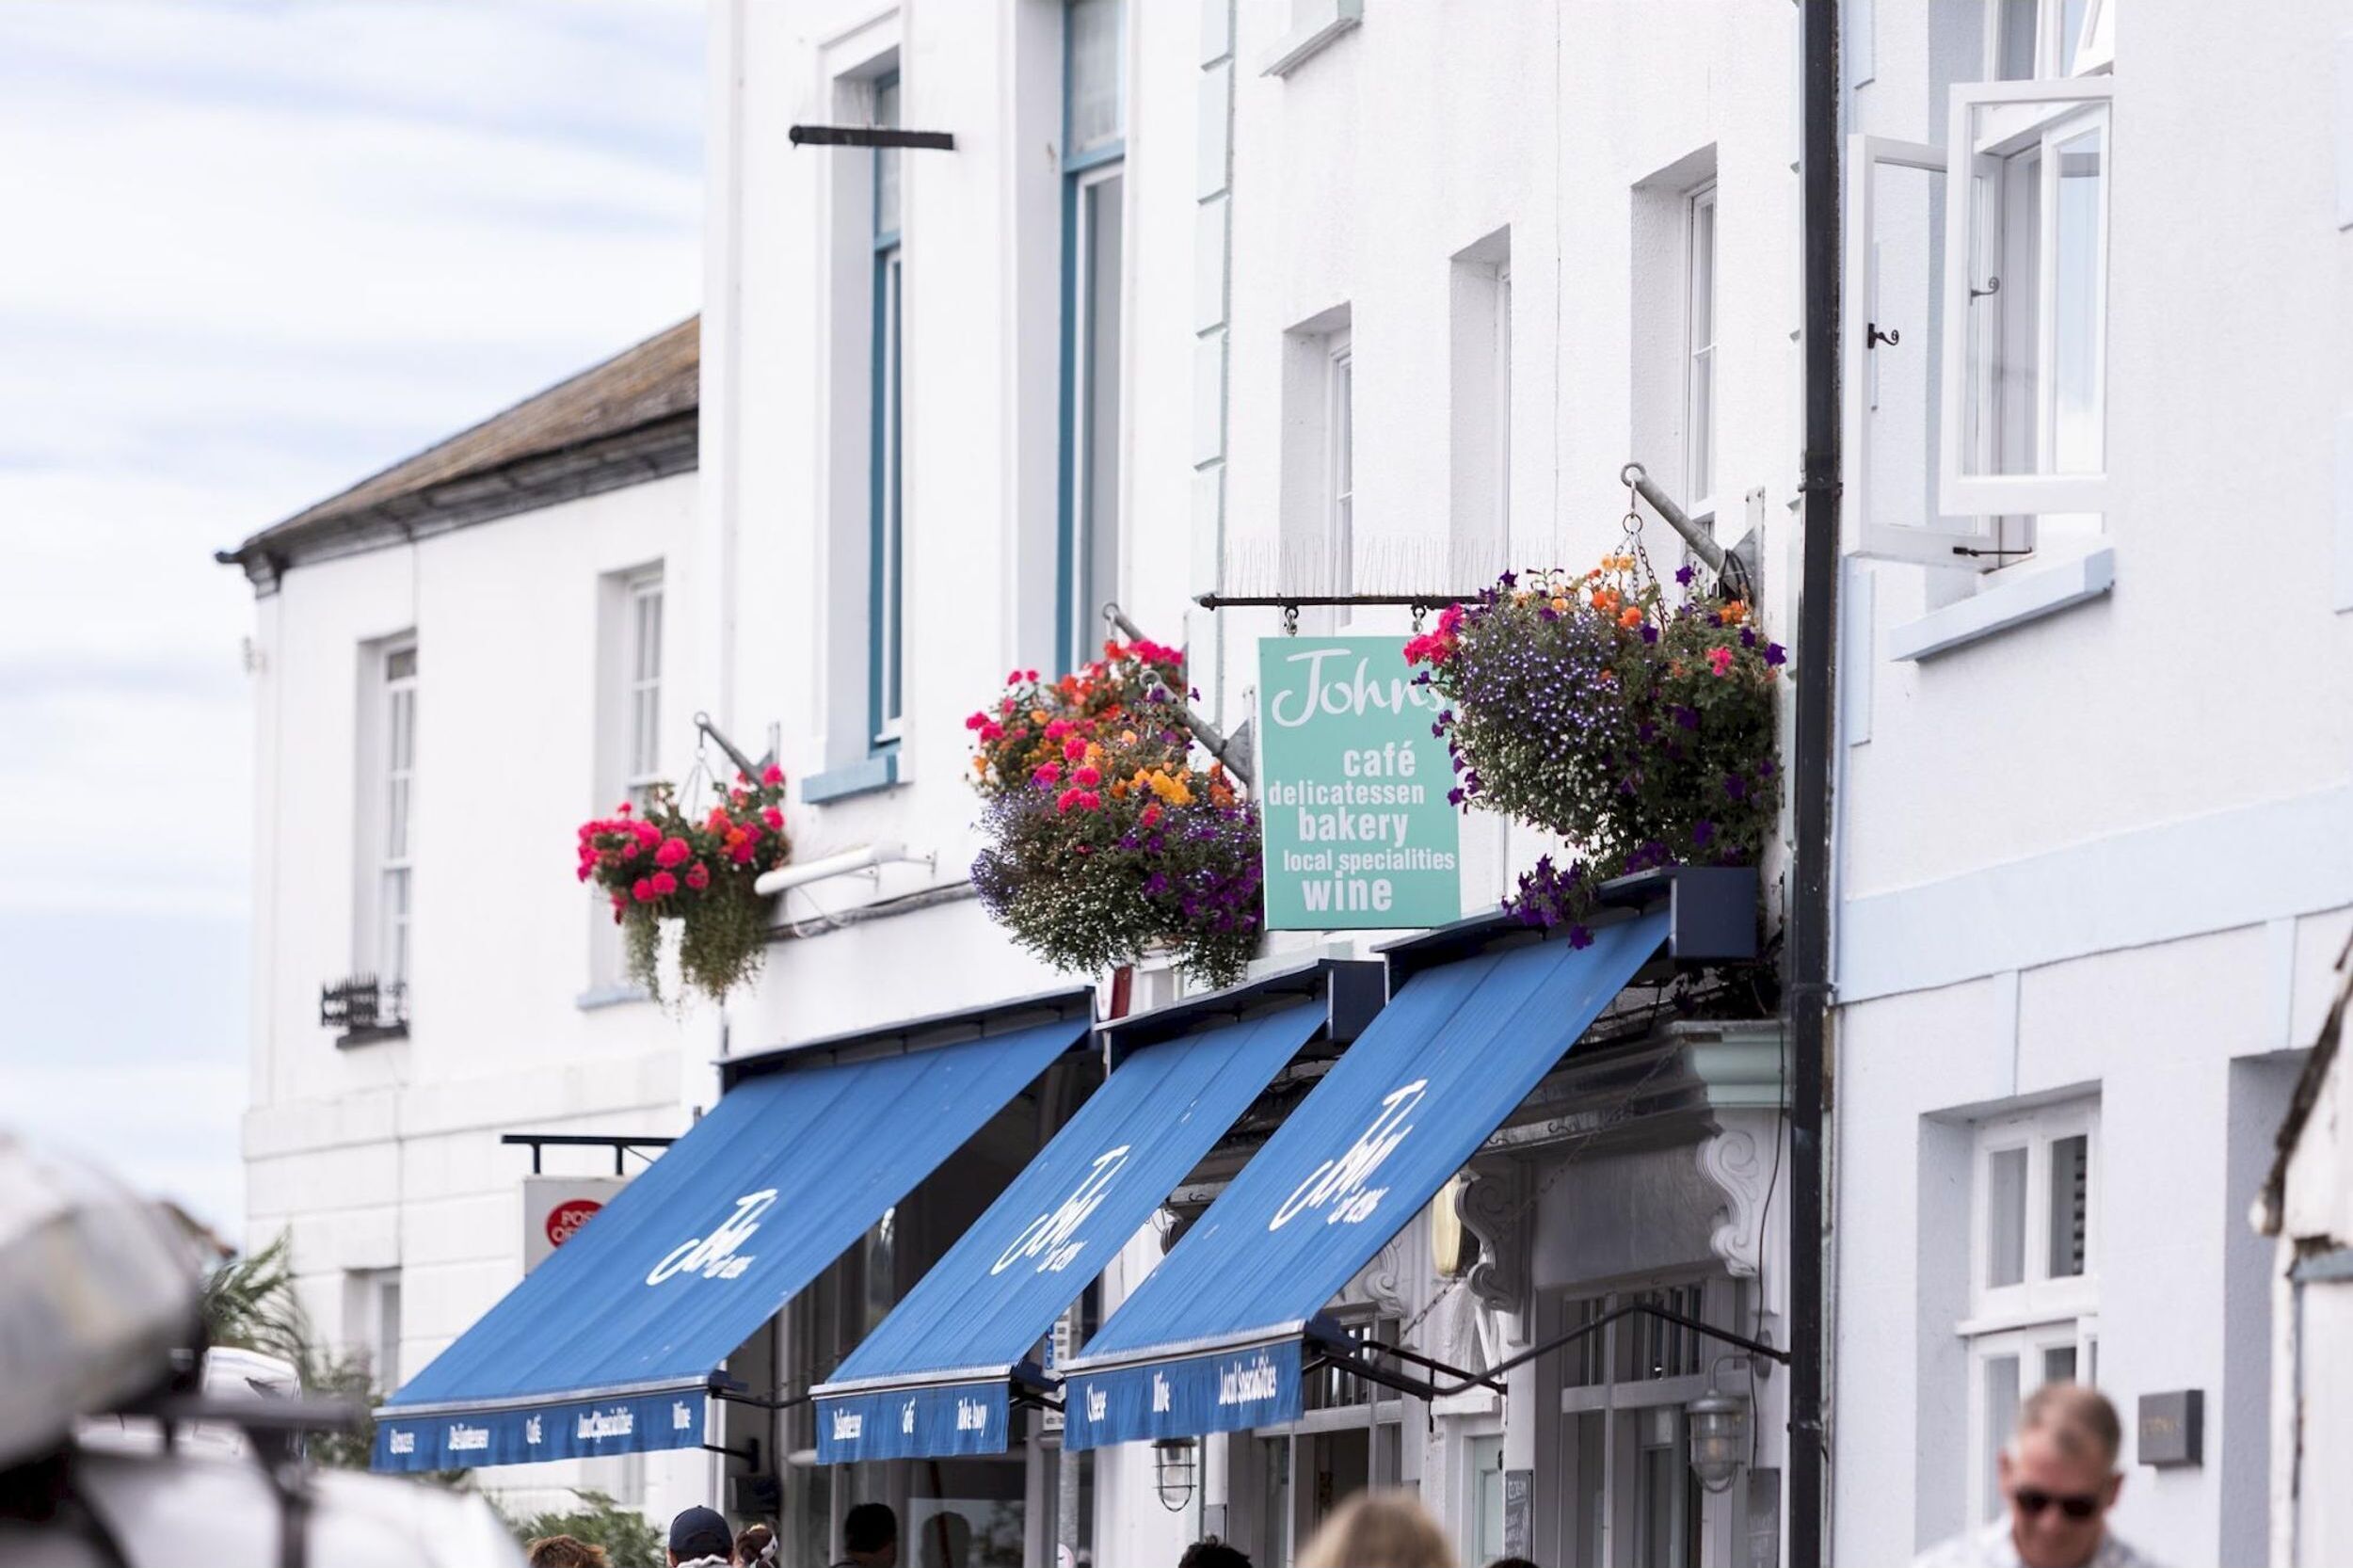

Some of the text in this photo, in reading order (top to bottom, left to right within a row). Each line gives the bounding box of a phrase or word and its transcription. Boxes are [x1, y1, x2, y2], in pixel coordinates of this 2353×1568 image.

[1272, 648, 1446, 727] Johns
[1344, 741, 1415, 777] café
[1269, 780, 1424, 806] delicatessen
[1299, 806, 1408, 847] bakery
[1284, 849, 1455, 874] local specialities
[1303, 872, 1392, 911] wine
[1153, 1371, 1170, 1412] Wine
[1219, 1361, 1238, 1405] Local
[1238, 1348, 1277, 1412] Specialities
